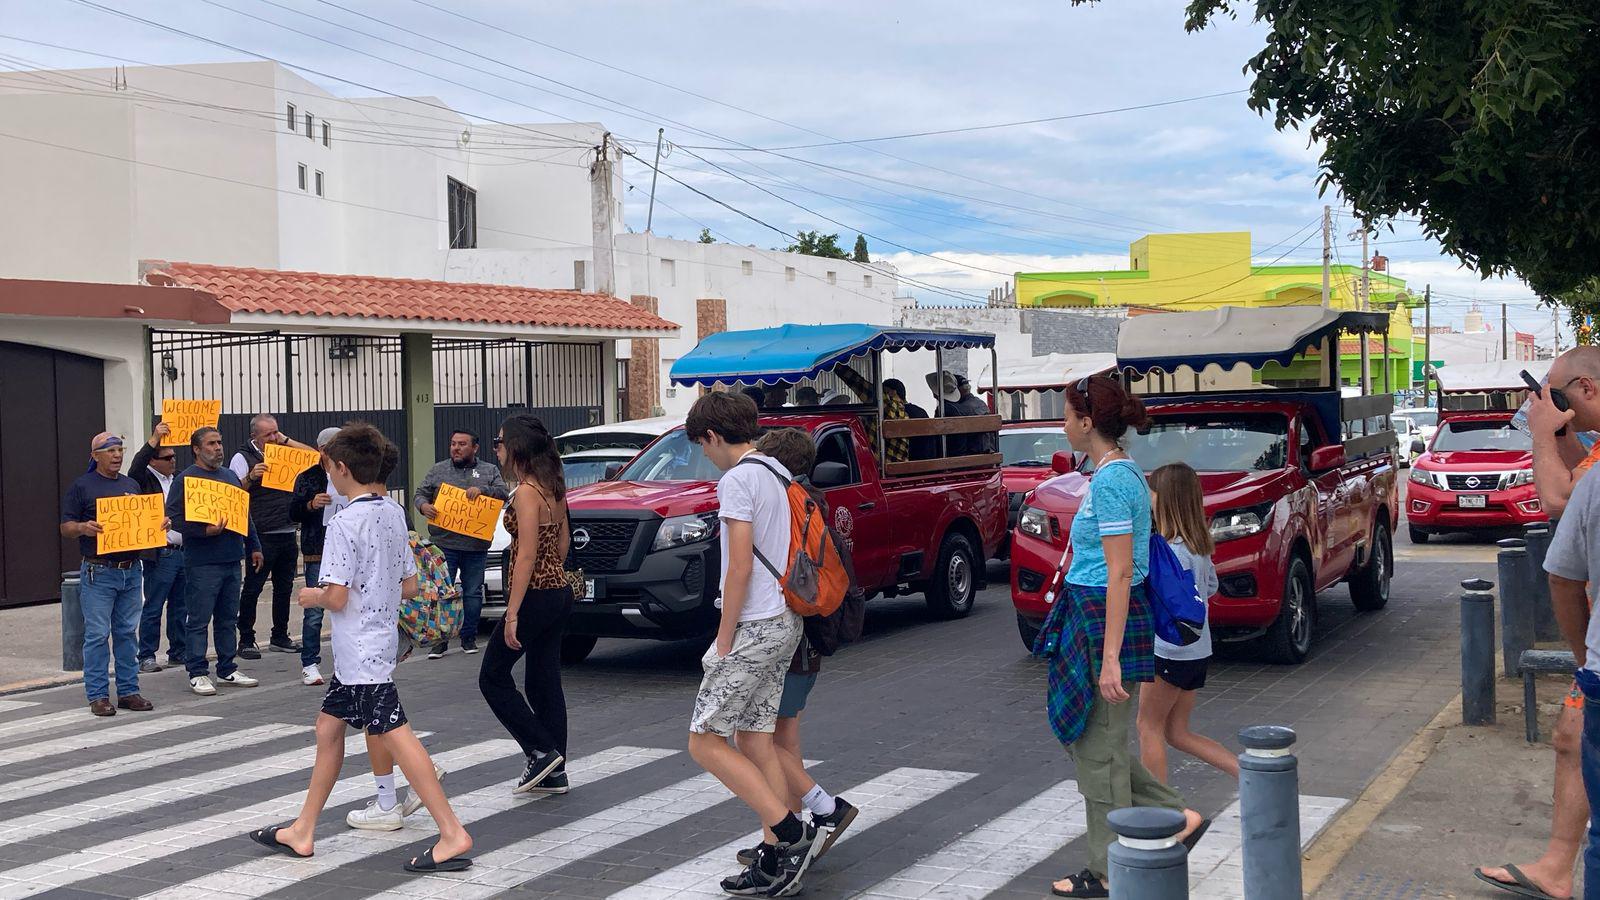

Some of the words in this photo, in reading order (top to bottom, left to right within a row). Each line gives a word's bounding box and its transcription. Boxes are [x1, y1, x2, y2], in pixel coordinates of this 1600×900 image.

[164, 400, 217, 415] WELCOME
[416, 393, 429, 404] 413
[266, 445, 317, 467] WELCOME
[187, 478, 246, 506] WELCOME
[99, 495, 159, 515] WELCOME
[187, 491, 248, 519] KIERSTEN
[443, 498, 483, 520] CARLY
[194, 505, 239, 528] SMITH
[434, 514, 488, 536] OMEZ
[103, 527, 157, 552] KEELER
